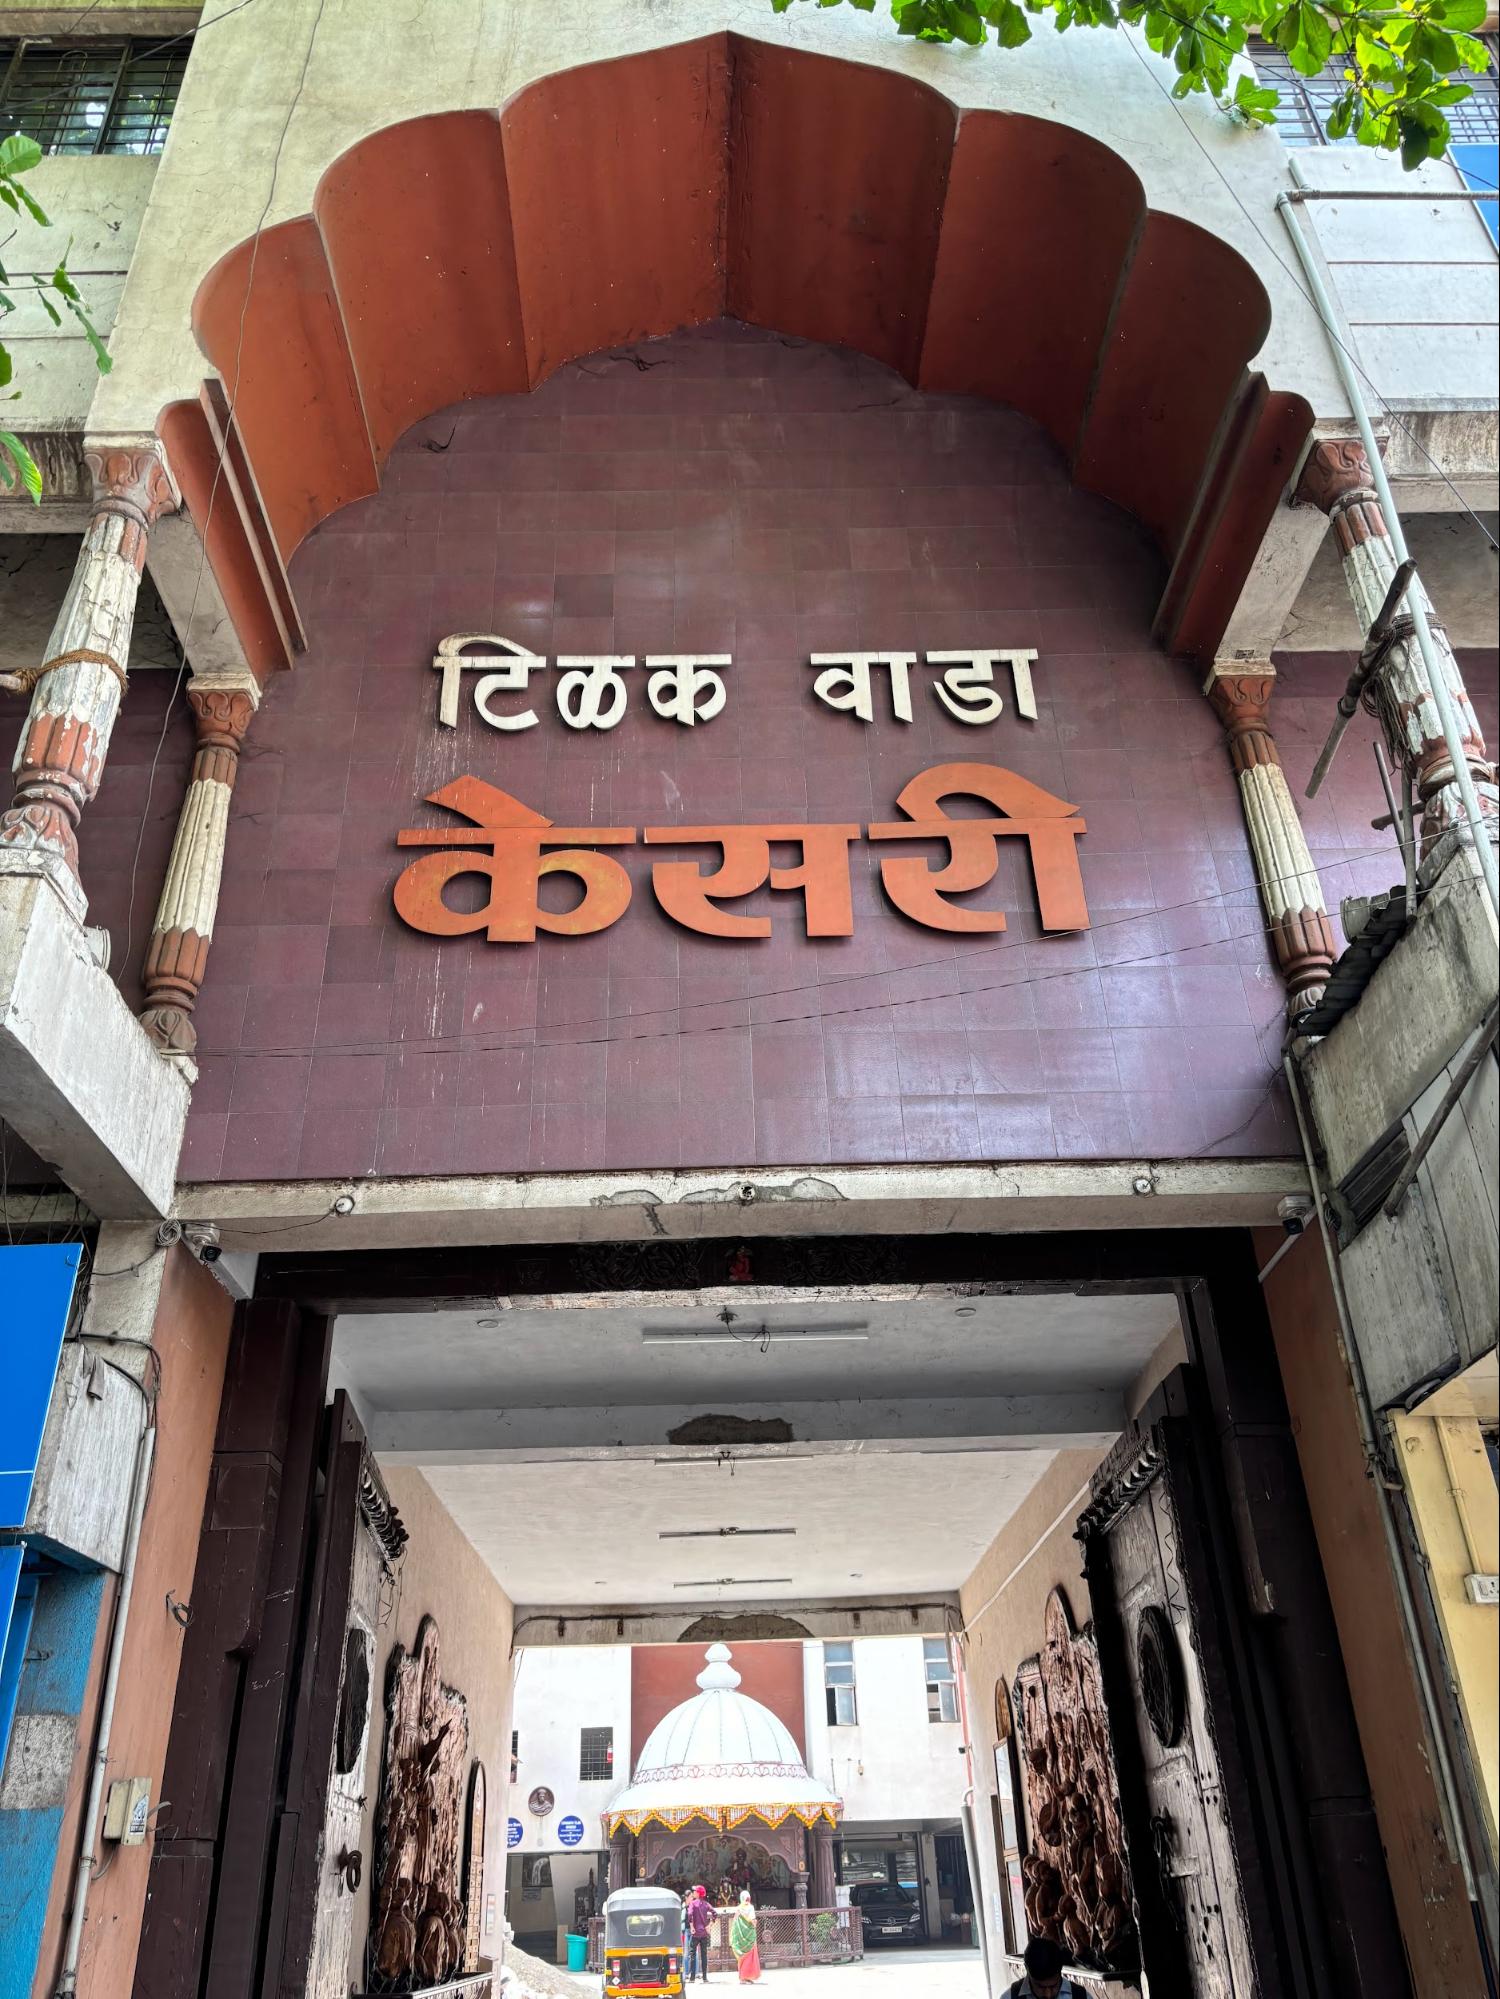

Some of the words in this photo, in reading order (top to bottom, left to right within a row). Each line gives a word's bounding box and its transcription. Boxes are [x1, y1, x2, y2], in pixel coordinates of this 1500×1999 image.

[433, 633, 732, 731] टिळक
[810, 648, 1039, 726] वाडा
[393, 763, 1091, 943] केसरी
